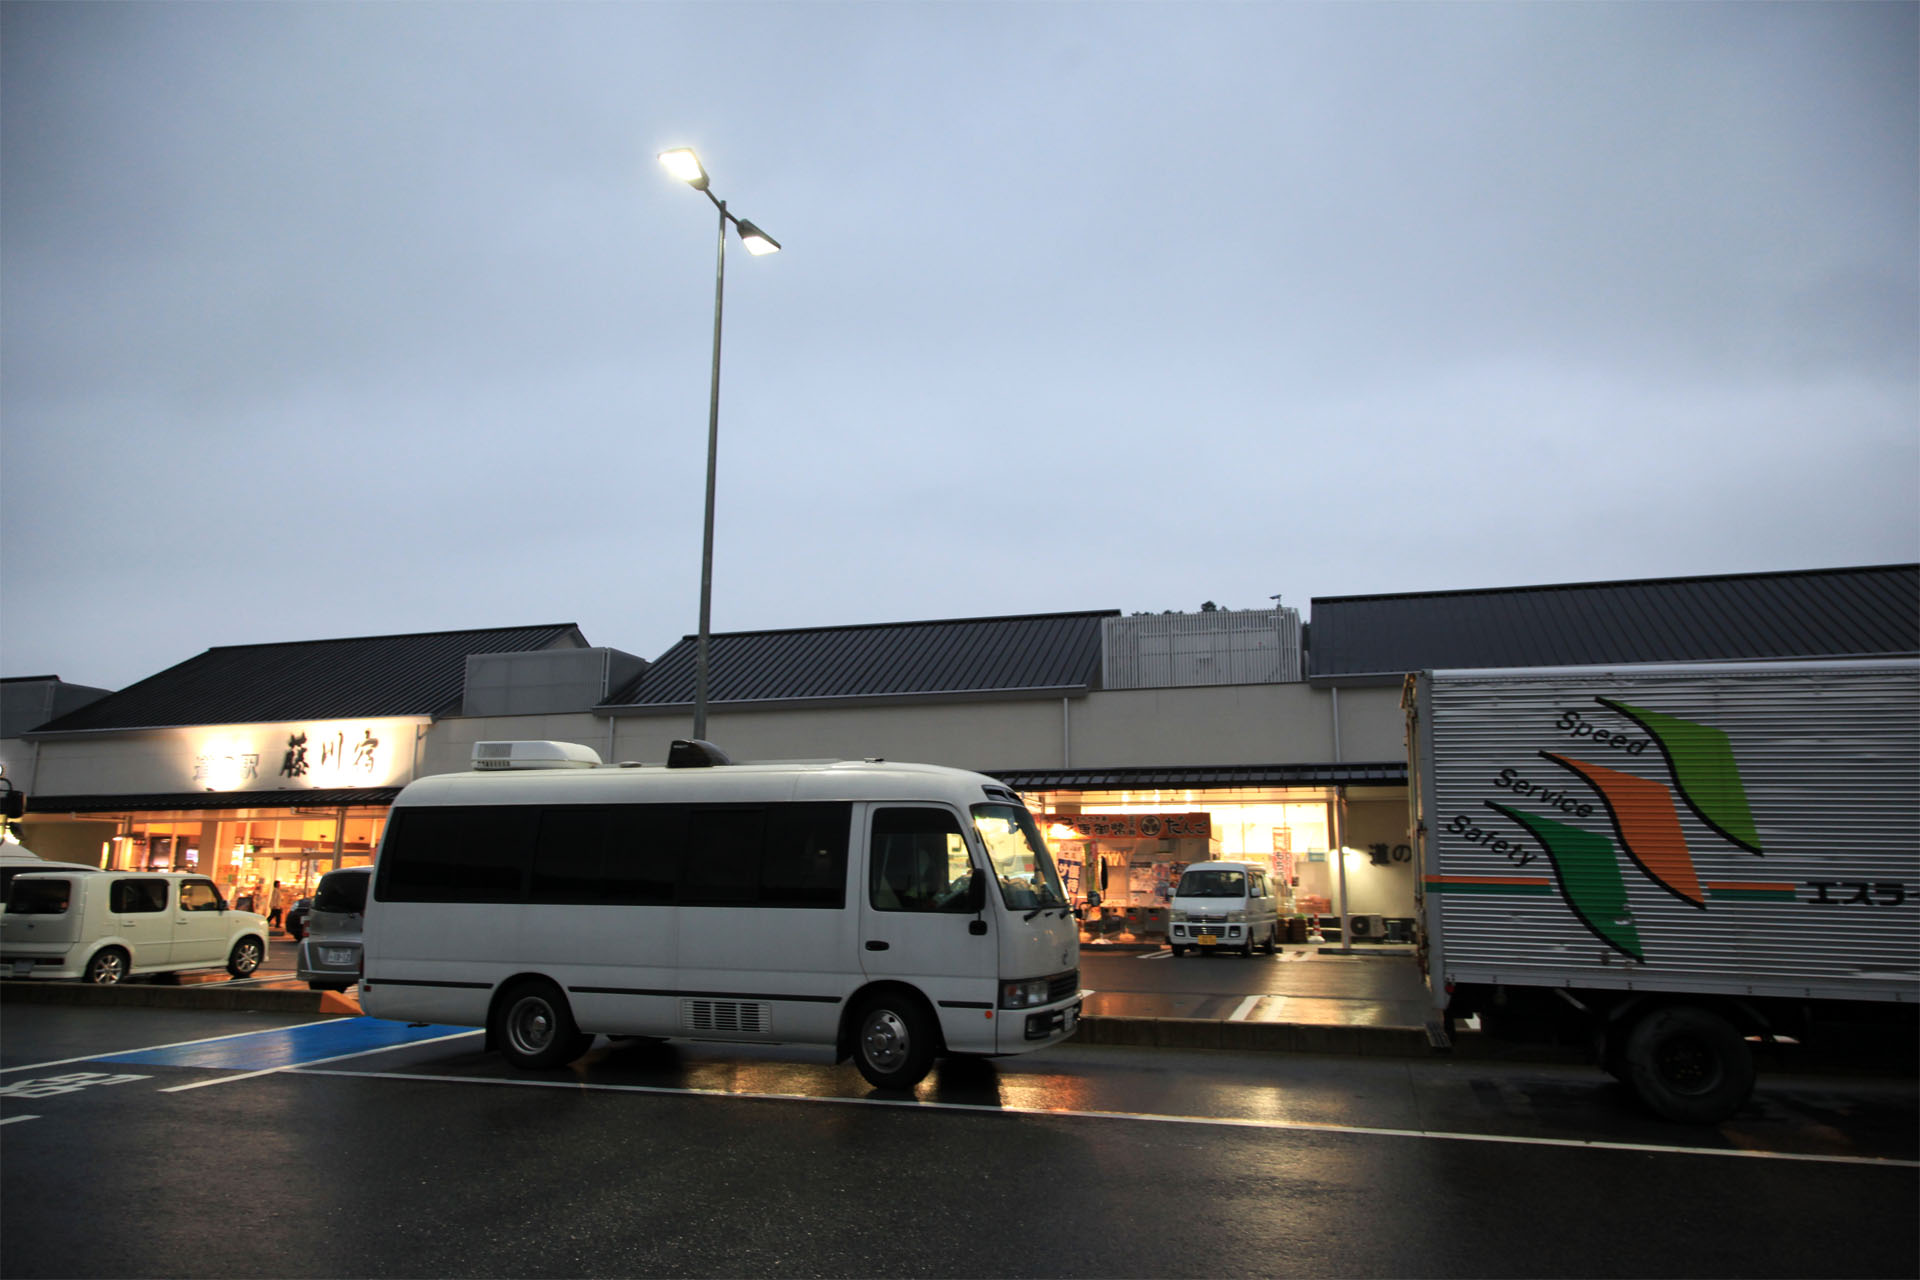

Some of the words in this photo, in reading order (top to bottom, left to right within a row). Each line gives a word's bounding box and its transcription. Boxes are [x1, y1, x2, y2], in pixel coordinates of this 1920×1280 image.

[1556, 711, 1650, 756] Speed
[1493, 768, 1593, 817] Service
[1165, 815, 1208, 835] だんご
[1447, 815, 1537, 867] Safety
[1807, 881, 1920, 906] エスラ
